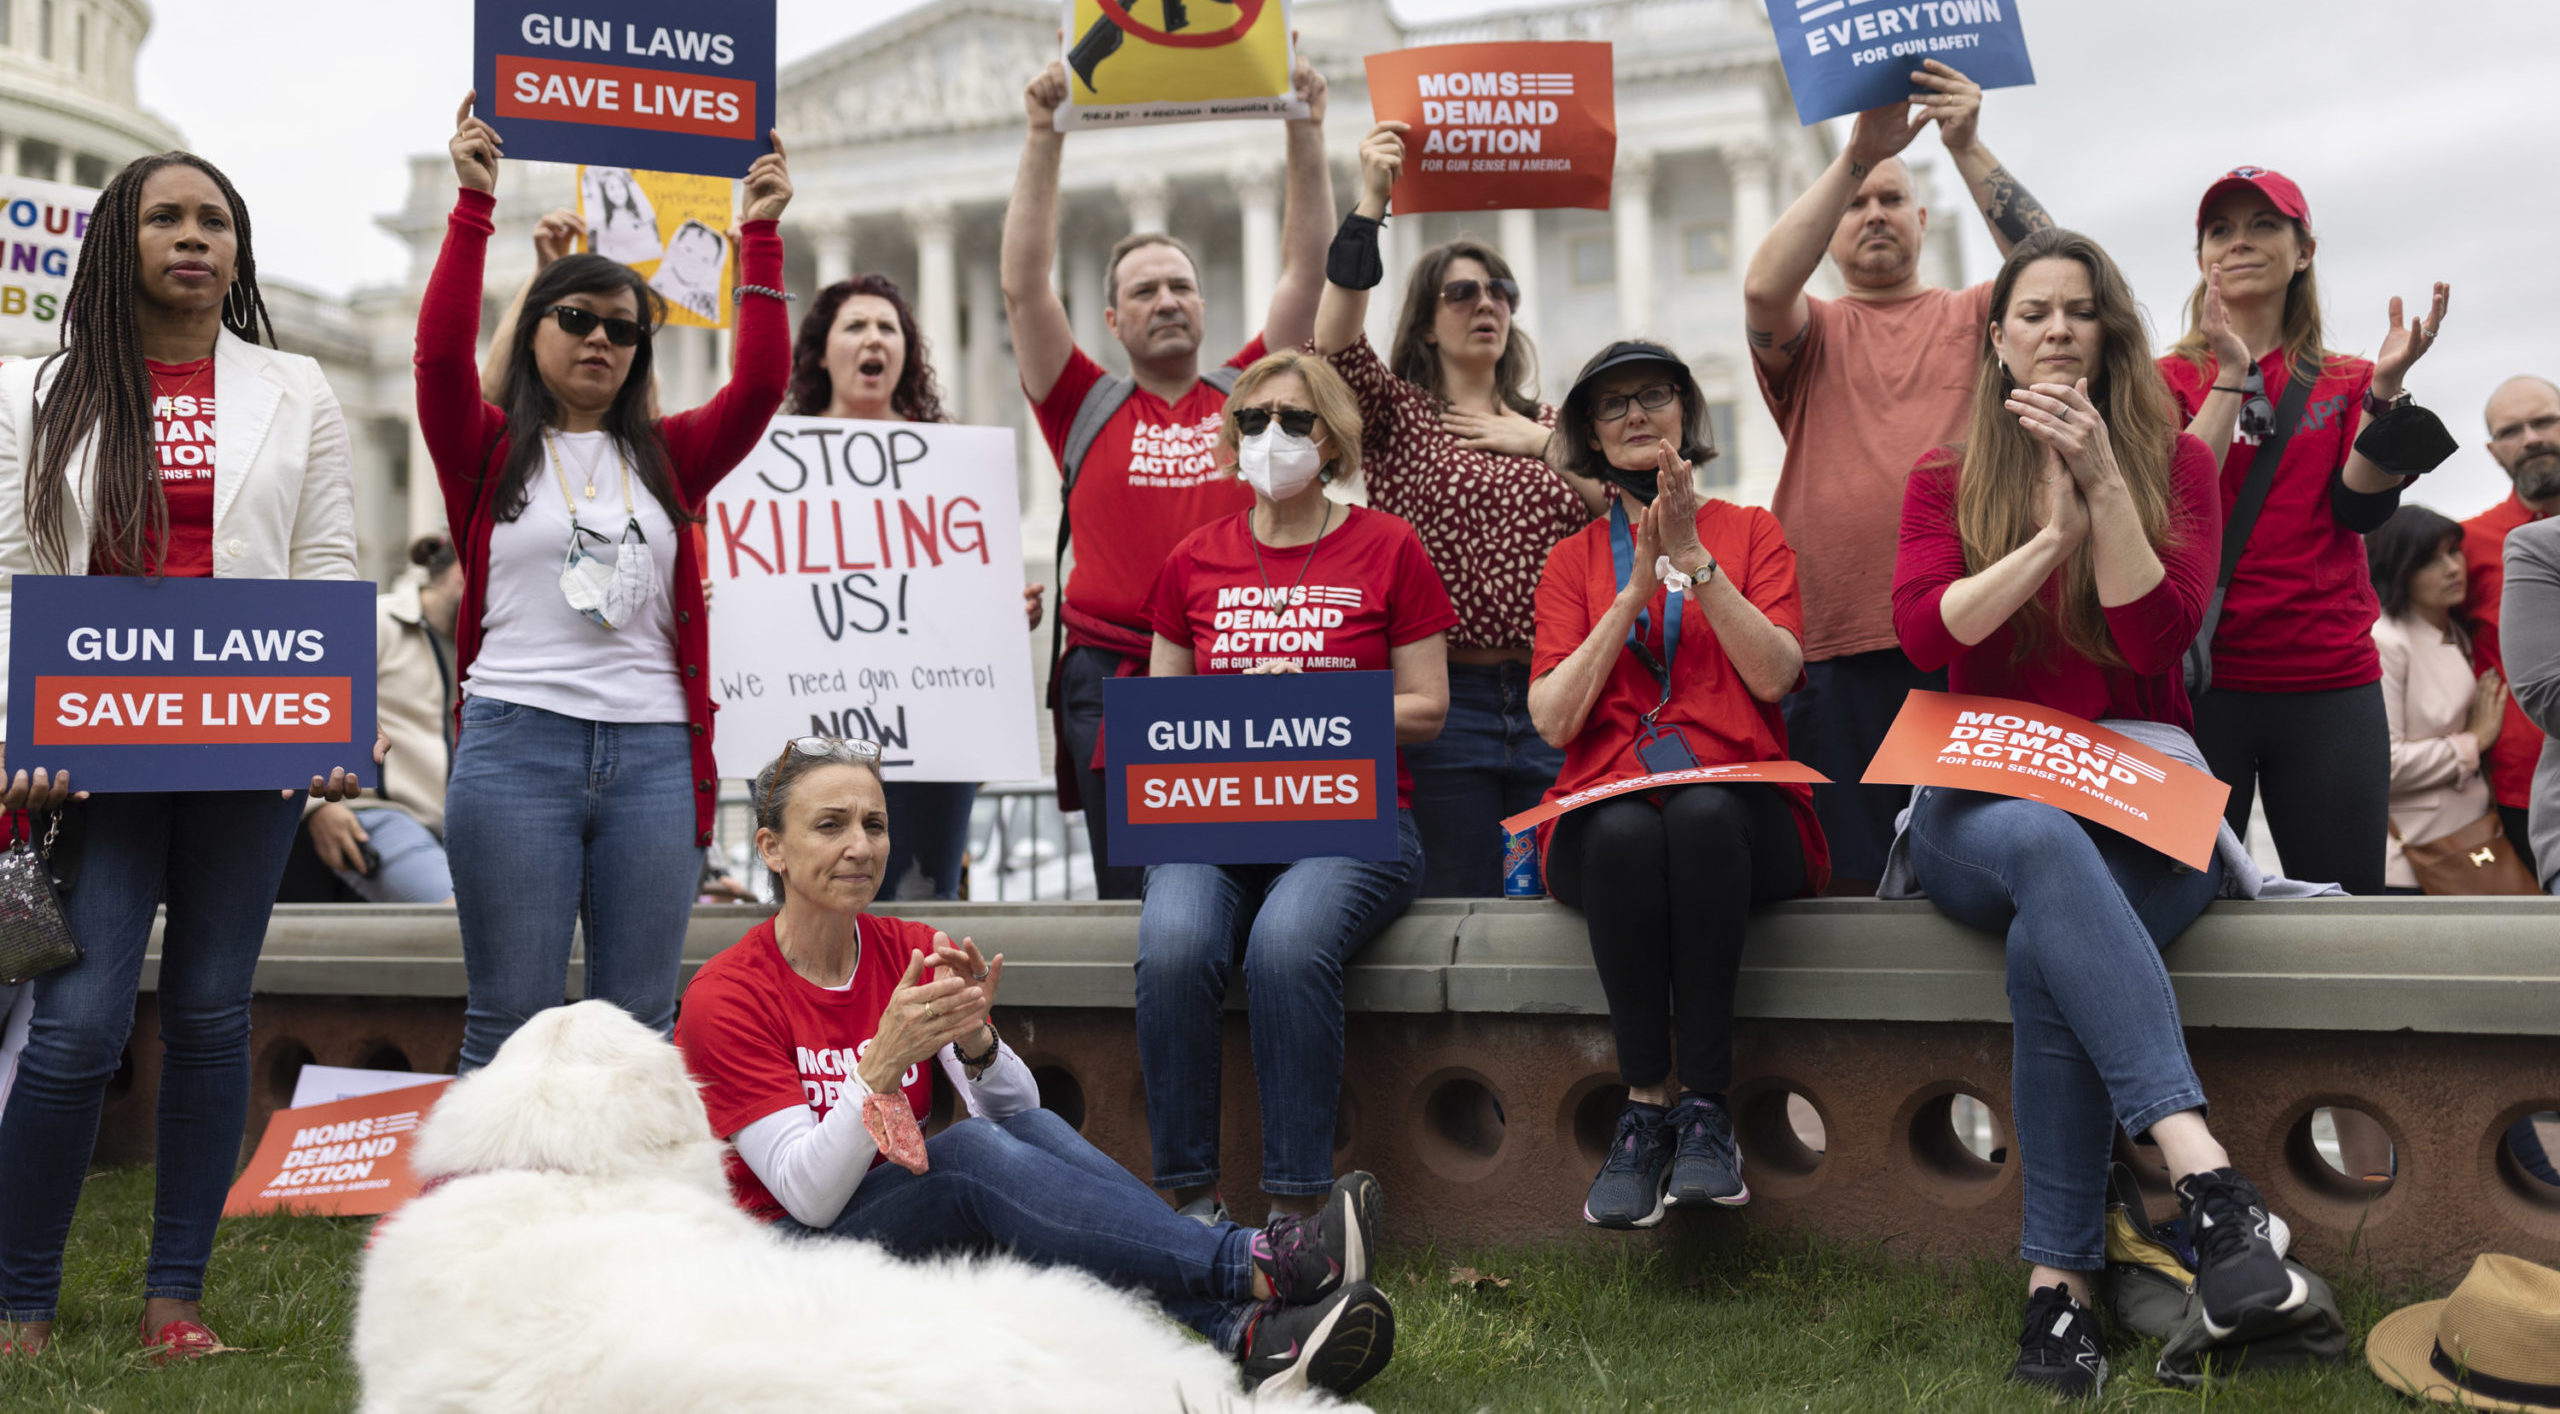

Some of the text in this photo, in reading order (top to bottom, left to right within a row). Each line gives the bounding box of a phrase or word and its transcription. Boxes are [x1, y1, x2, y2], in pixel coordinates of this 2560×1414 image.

[521, 13, 735, 66] GUN LAWS
[1805, 0, 2002, 56] EVERYTOWN
[1852, 33, 1980, 67] FOR GUN SAFETY
[513, 71, 740, 123] SAVE LIVES
[1418, 72, 1520, 97] MOMS
[1422, 100, 1559, 125] DEMAND
[1422, 129, 1541, 153] ACTION
[1421, 158, 1571, 171] FOR GUN SENSE IN AMERICA
[757, 429, 929, 493] STOP
[1131, 432, 1219, 458] DEMAND
[196, 468, 212, 479] IN
[1128, 450, 1216, 476] ACTION
[716, 494, 990, 579] KILLING
[812, 573, 909, 642] US!
[1217, 585, 1307, 609] MOMS
[1213, 607, 1344, 630] DEMAND
[67, 627, 325, 663] GUN LAWS
[1211, 631, 1324, 653] ACTION
[1211, 657, 1228, 669] FOR
[1231, 657, 1253, 669] GUN
[1306, 657, 1357, 669] AMERICA
[787, 669, 848, 697] need
[859, 667, 899, 706] gun
[911, 664, 996, 690] control
[56, 692, 332, 727] SAVE LIVES
[810, 705, 909, 750] NOW
[1147, 716, 1352, 751] GUN LAWS
[1956, 711, 2092, 750] MOMS
[1940, 740, 2109, 791] ACTION
[1949, 725, 2139, 786] DEMAND
[1143, 774, 1360, 809] SAVE LIVES
[1936, 755, 2149, 821] FOR GUN SENSE IN AMERICA
[292, 1118, 374, 1149] MOMS
[281, 1136, 398, 1170] DEMAND
[267, 1160, 375, 1188] ACTION
